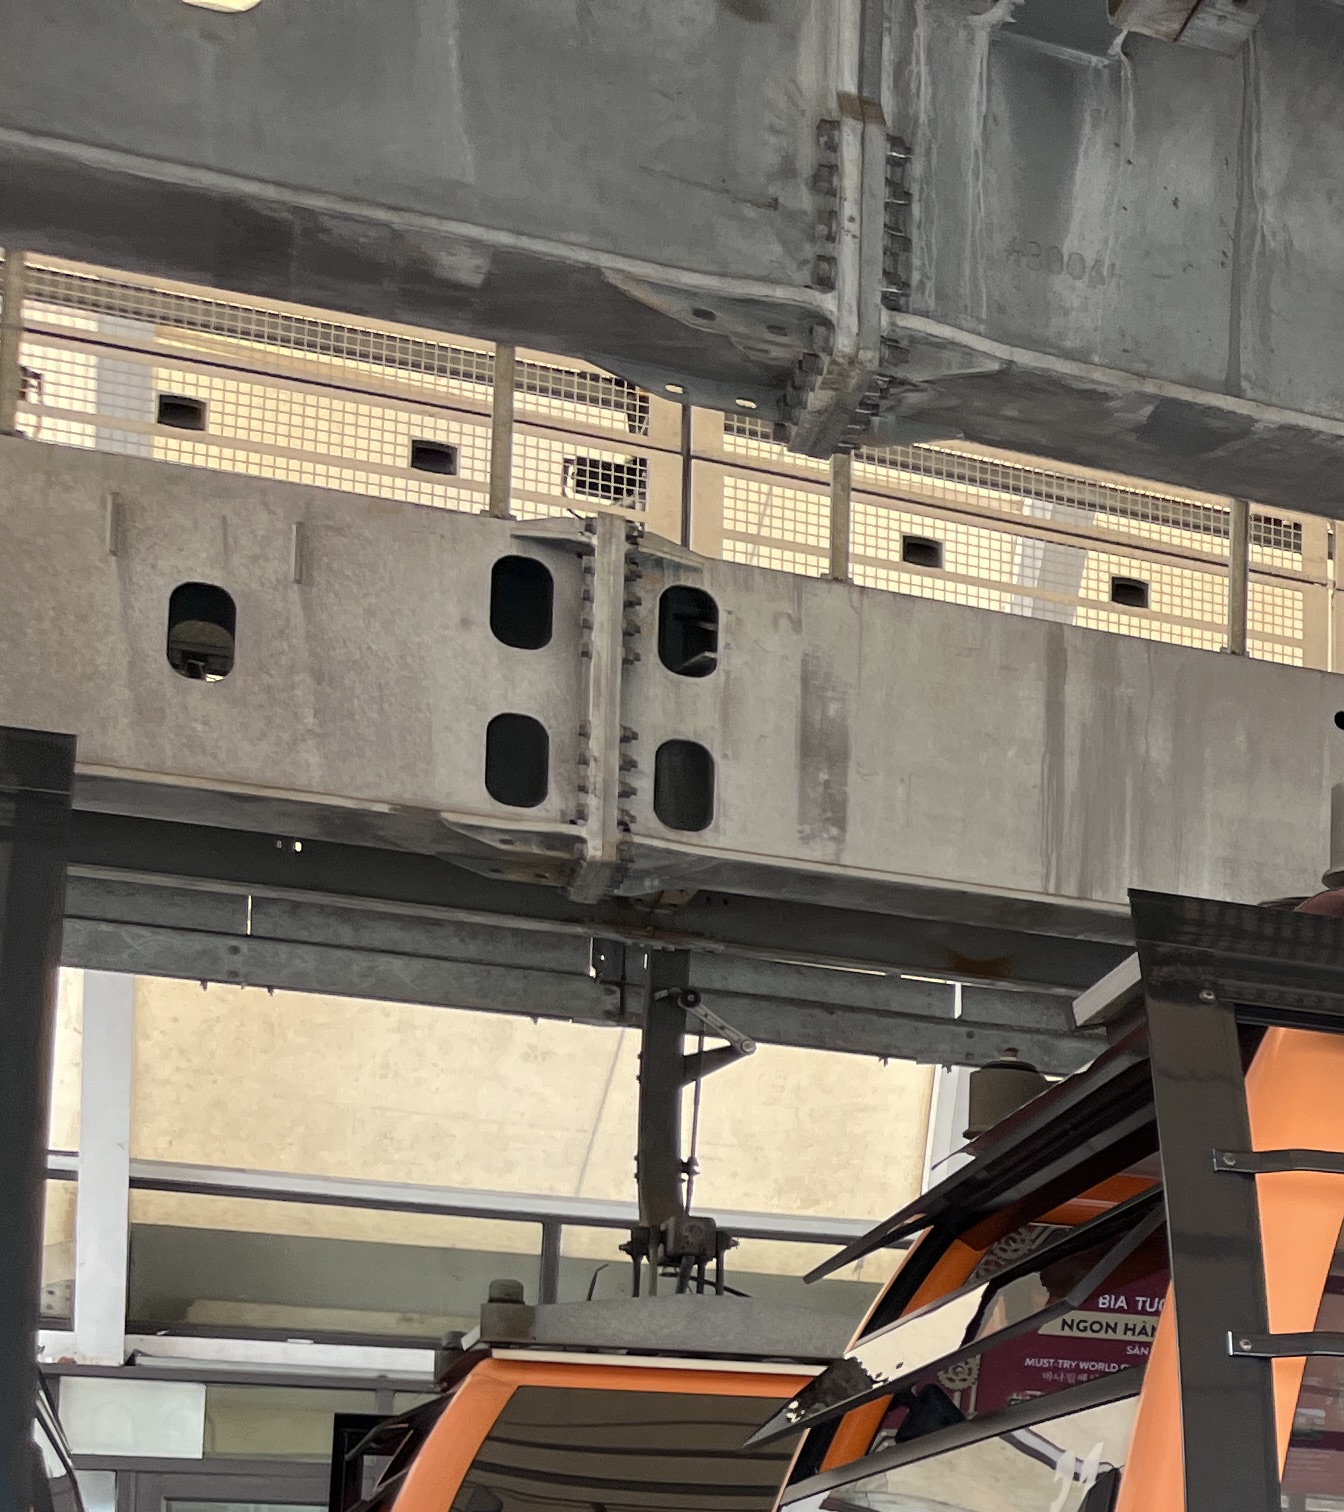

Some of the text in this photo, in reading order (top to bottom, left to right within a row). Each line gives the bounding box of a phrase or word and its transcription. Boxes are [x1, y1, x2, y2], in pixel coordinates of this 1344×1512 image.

[1098, 1294, 1127, 1310] BIA
[1061, 1318, 1118, 1335] NGON
[1079, 1361, 1119, 1373] WORLD
